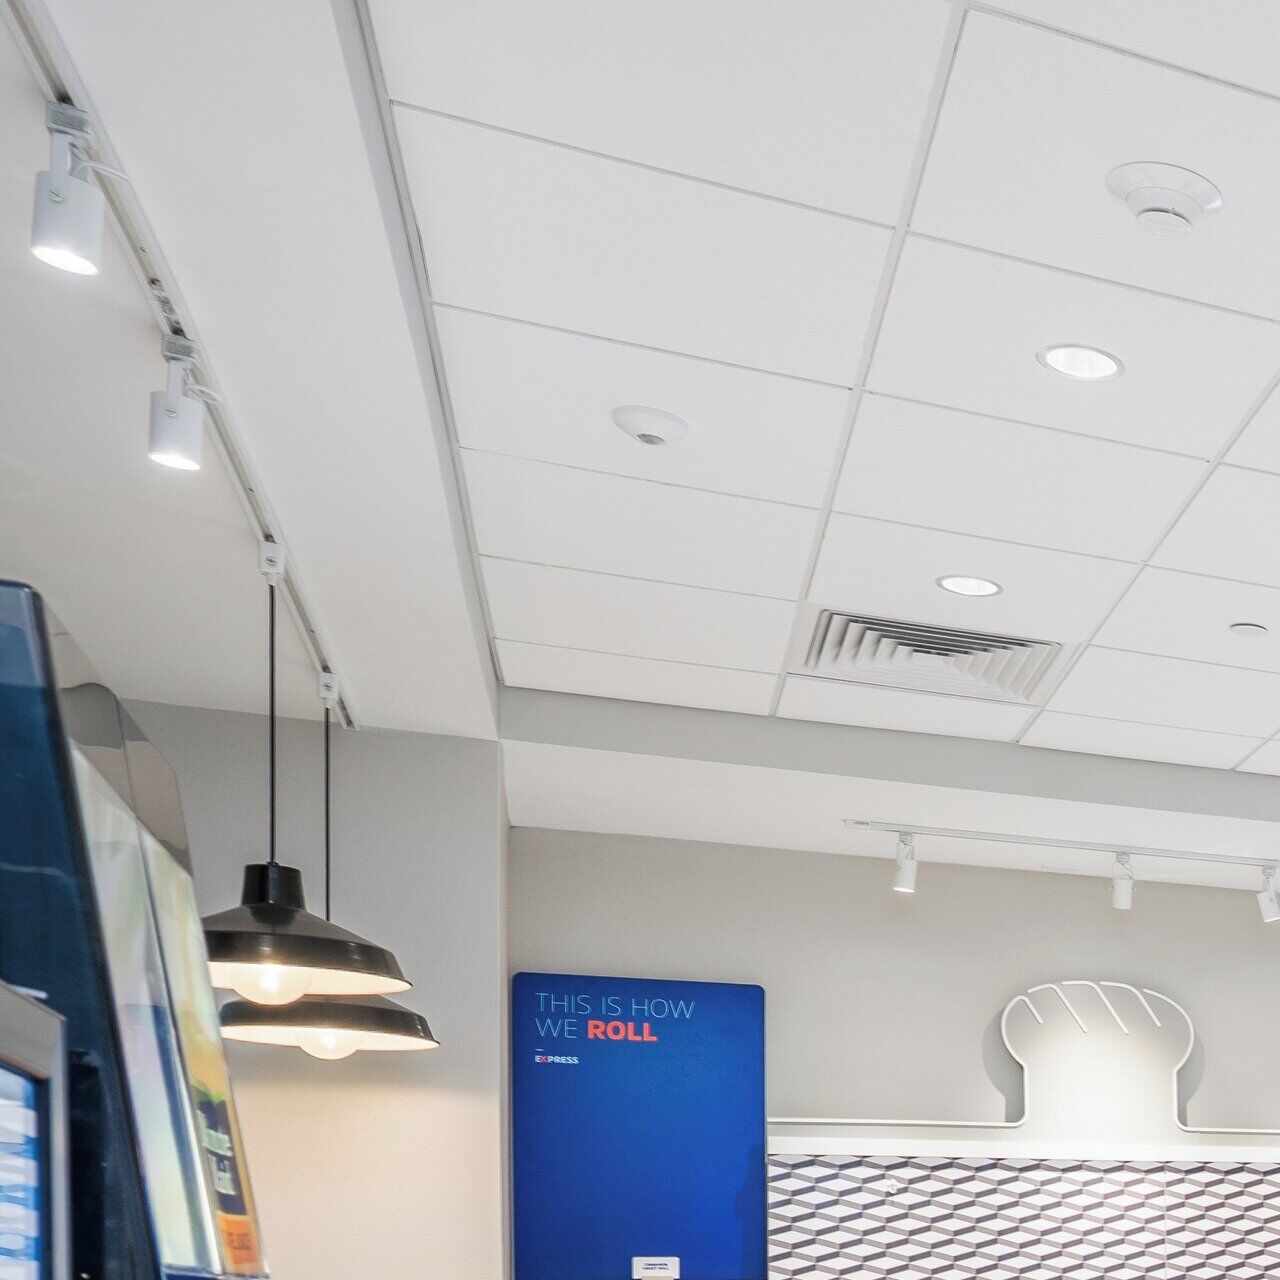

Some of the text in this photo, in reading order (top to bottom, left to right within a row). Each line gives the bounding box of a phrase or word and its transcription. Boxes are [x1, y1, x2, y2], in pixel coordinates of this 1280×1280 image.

[535, 992, 696, 1019] THIS IS HOW
[535, 1018, 659, 1042] WE ROLL
[534, 1055, 580, 1065] EXPRESS
